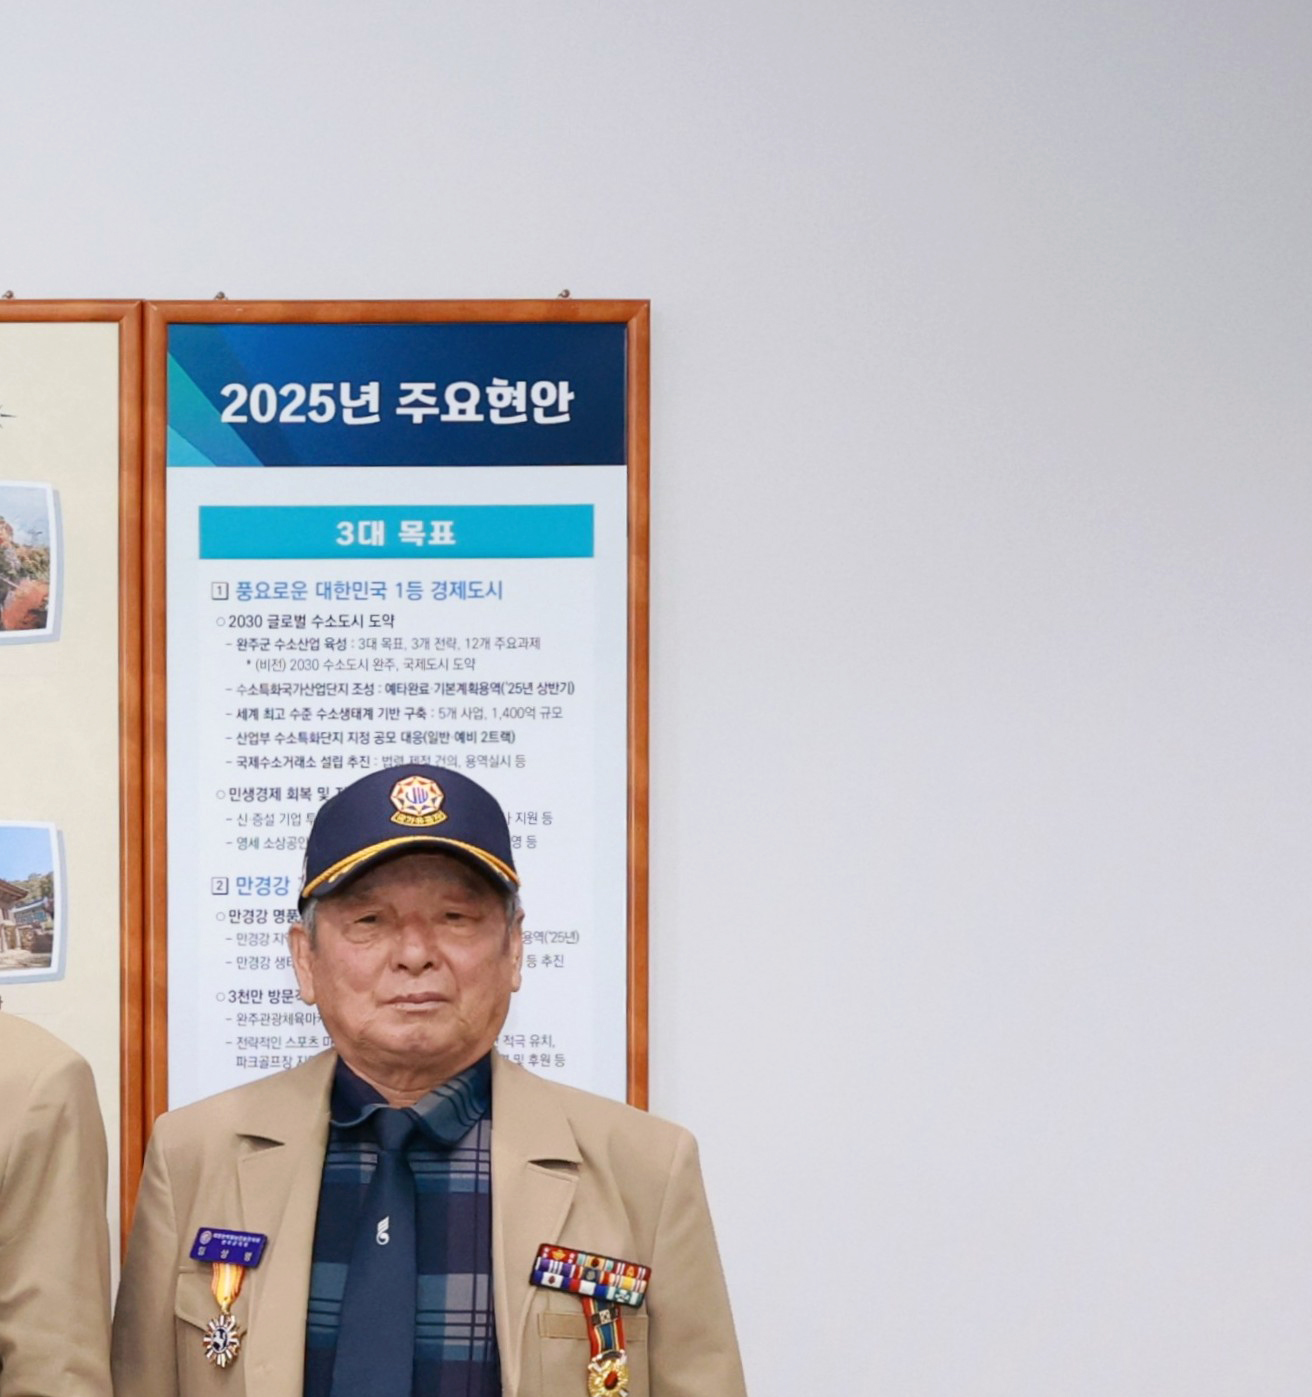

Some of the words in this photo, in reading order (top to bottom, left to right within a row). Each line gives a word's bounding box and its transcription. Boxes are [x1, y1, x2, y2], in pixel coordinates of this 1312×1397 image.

[218, 382, 380, 427] 2025년
[396, 378, 575, 424] 주요현안
[336, 520, 386, 546] 3대
[398, 520, 456, 546] 목표
[236, 581, 308, 602] 풍요로운
[316, 581, 387, 600] 대한민국
[396, 581, 423, 601] 1등
[431, 581, 502, 601] 경제도시
[229, 614, 263, 628] 2030
[267, 614, 306, 629] 글로벌
[312, 614, 363, 629] 수소도시
[368, 614, 395, 628] 도약
[237, 638, 270, 651] 완주군
[274, 637, 320, 651] 수소산업
[358, 638, 377, 651] 3대
[381, 637, 407, 650] 목표,
[412, 637, 430, 650] 3개
[466, 637, 490, 650] 12개
[495, 637, 540, 650] 주요과제
[256, 658, 286, 672] (비전)
[290, 658, 319, 671] 2030
[323, 658, 368, 672] 수소도시
[372, 658, 398, 672] 완주,
[403, 658, 448, 671] 국제도시
[453, 658, 476, 671] 도약
[237, 683, 348, 696] 수소특화국가산업단지
[352, 683, 374, 696] 조성
[537, 681, 575, 695] 상반기)
[237, 708, 259, 721] 세계
[264, 708, 285, 720] 최고
[290, 707, 312, 721] 수준
[317, 707, 373, 721] 수소생태계
[378, 707, 400, 720] 기반
[404, 707, 427, 720] 구축
[438, 707, 457, 720] 5개
[461, 707, 487, 720] 사업,
[493, 706, 536, 720] 1,400억
[540, 706, 563, 719] 규모
[236, 732, 270, 745] 산업부
[275, 731, 343, 745] 수소특화단지
[347, 731, 370, 745] 지정
[374, 731, 396, 745] 공모
[481, 730, 515, 744] 2트랙)
[237, 756, 316, 769] 국제수소거래소
[321, 755, 343, 769] 설립
[347, 755, 370, 768] 추진
[465, 754, 511, 769] 용역실시
[515, 754, 526, 768] 등
[229, 787, 281, 802] 민생경제
[287, 787, 312, 801] 회복
[280, 813, 301, 826] 기업
[515, 811, 537, 825] 지원
[542, 811, 553, 825] 등
[237, 837, 259, 851] 영세
[526, 835, 537, 849] 등
[236, 876, 290, 896] 만경강
[229, 909, 268, 924] 만경강
[236, 933, 270, 946] 만경강
[236, 956, 271, 970] 만경강
[526, 954, 537, 968] 등
[541, 954, 564, 968] 추진
[229, 989, 263, 1004] 3천만
[237, 1036, 281, 1050] 전략적인
[286, 1036, 319, 1048] 스포츠
[503, 1035, 525, 1048] 적극
[529, 1034, 555, 1048] 유치,
[528, 1053, 550, 1067] 후원
[554, 1054, 565, 1068] 등
